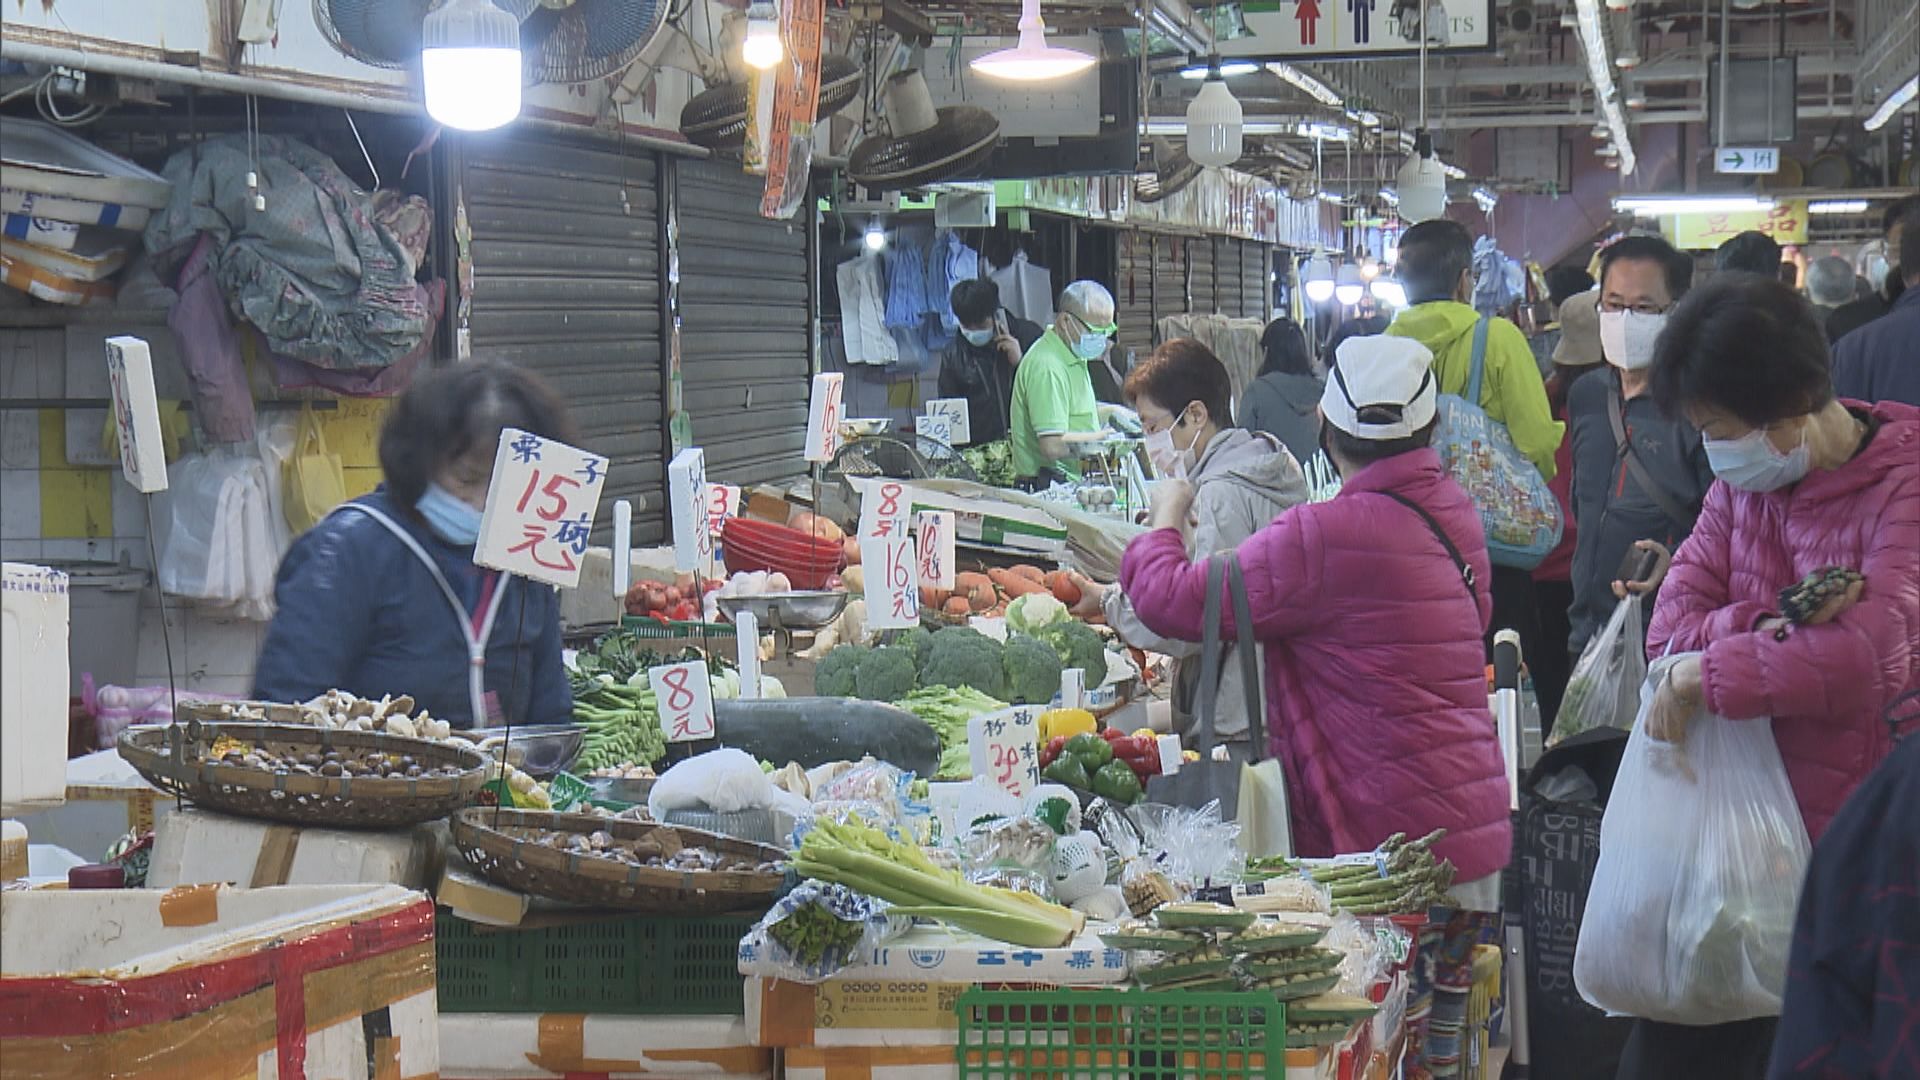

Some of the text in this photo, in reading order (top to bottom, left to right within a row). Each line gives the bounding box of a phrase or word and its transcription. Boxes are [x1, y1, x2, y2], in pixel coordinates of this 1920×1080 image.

[822, 379, 841, 433] 16
[516, 469, 581, 521] 15
[708, 486, 728, 515] 3
[878, 482, 902, 516] 8
[507, 524, 577, 571] 元
[919, 523, 936, 561] 10
[886, 541, 909, 590] 16
[892, 590, 920, 620] 元
[662, 667, 695, 712] 8
[672, 712, 714, 739] 元
